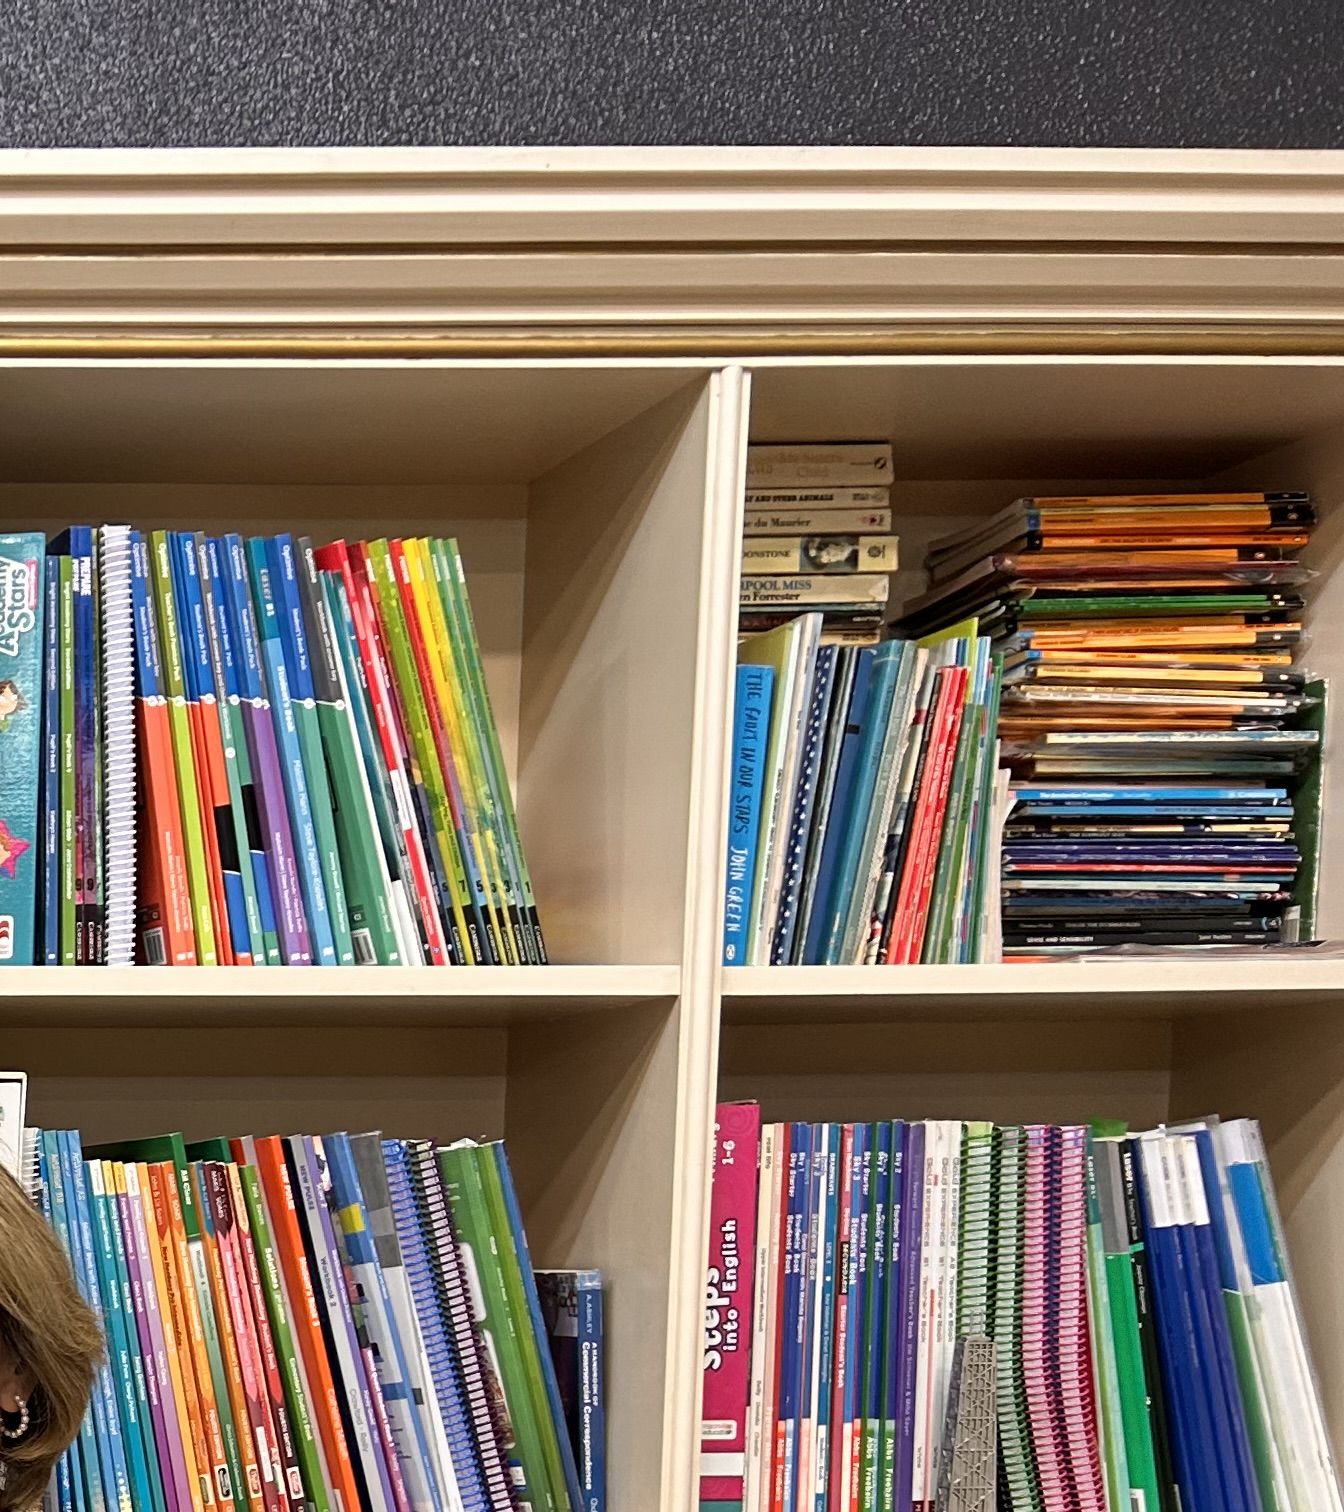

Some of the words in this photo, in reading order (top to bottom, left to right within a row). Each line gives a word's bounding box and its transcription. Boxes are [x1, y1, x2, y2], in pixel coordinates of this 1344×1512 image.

[759, 518, 769, 527] du
[772, 518, 812, 527] Maurier
[6, 568, 31, 629] Stars
[752, 592, 800, 601] Forrester
[784, 581, 812, 590] MISS
[745, 673, 762, 694] THE
[747, 706, 761, 742] FAULT
[744, 747, 757, 766] IN
[734, 795, 752, 834] STARS
[731, 845, 748, 881] JOHN
[726, 886, 744, 932] GREEN
[722, 1140, 736, 1165] 1-6
[722, 1219, 737, 1292] English
[723, 1308, 738, 1351] into
[581, 1341, 592, 1404] Commercial
[583, 1405, 593, 1490] Correspondence
